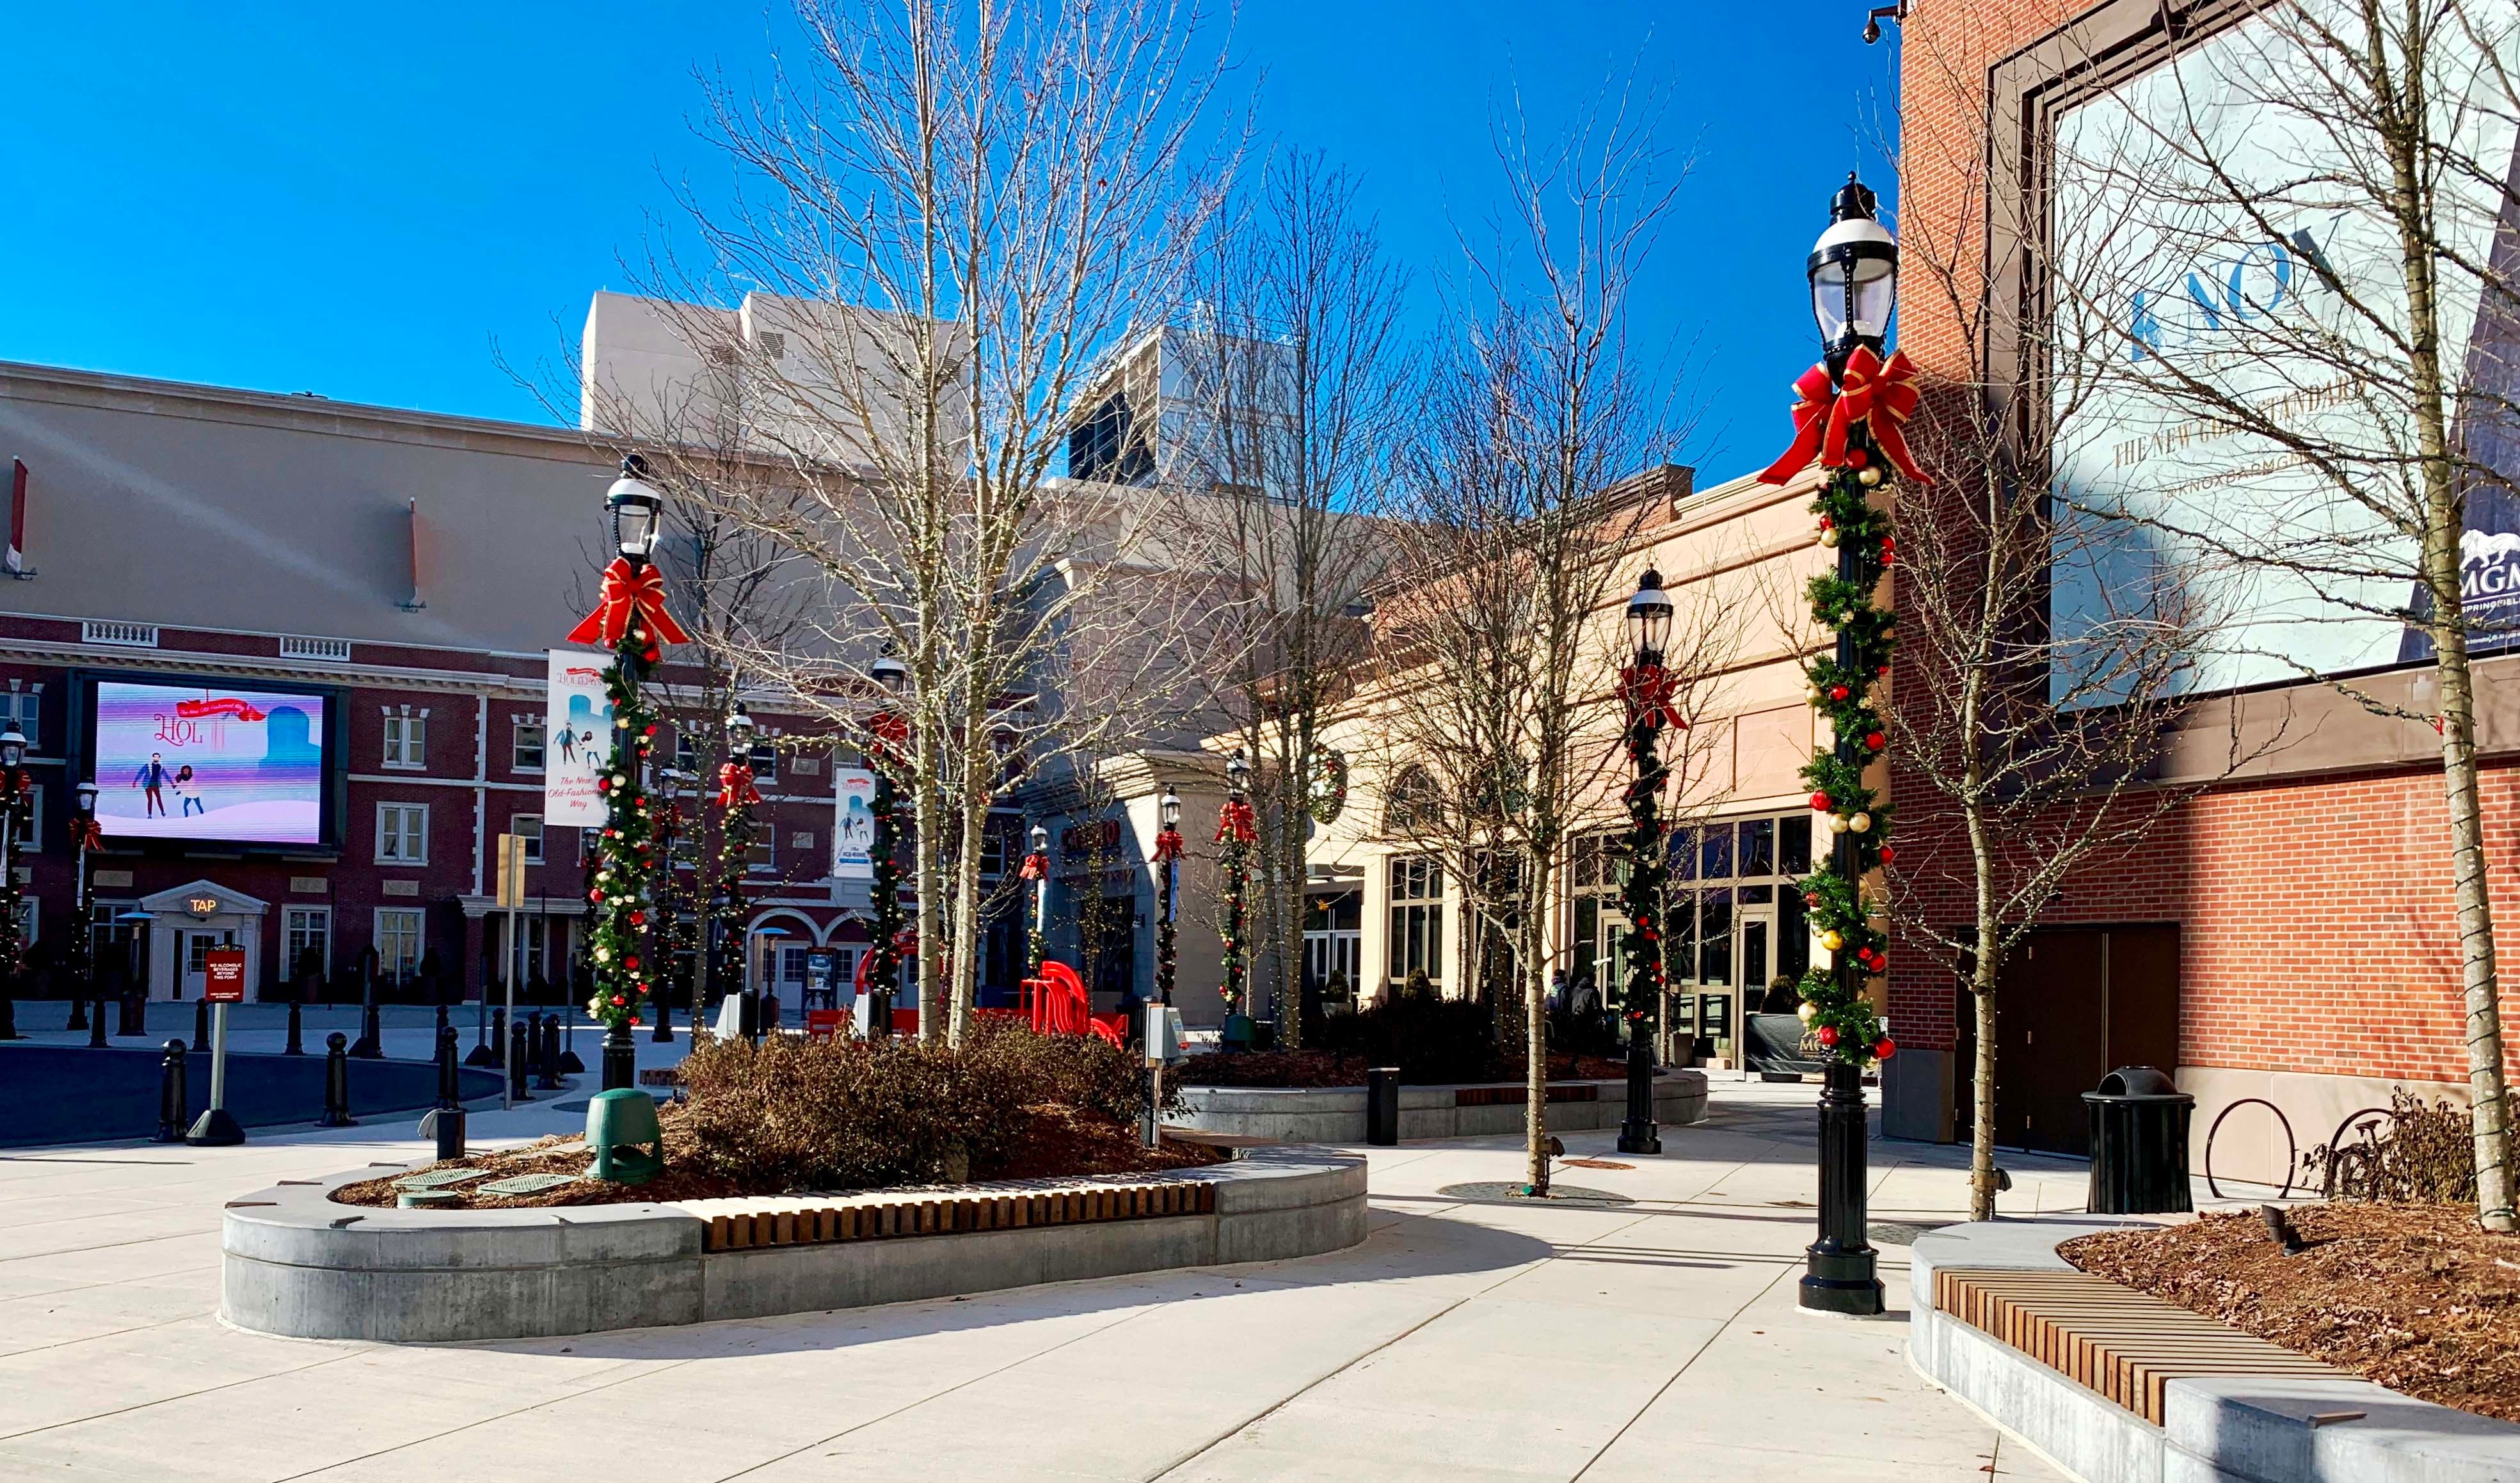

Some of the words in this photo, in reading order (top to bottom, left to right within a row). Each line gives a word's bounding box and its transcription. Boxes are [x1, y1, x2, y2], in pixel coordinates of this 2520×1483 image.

[2113, 436, 2147, 469] THE
[2152, 422, 2192, 457] NEW
[2199, 408, 2249, 443] GOL
[2256, 374, 2366, 424] TANDARD
[2462, 598, 2520, 614] SPRINGFIEL
[561, 776, 573, 785] The
[576, 776, 592, 784] New
[548, 788, 602, 798] Old-Fashione
[570, 798, 587, 811] Way
[1061, 818, 1120, 852] CASNO
[190, 899, 216, 912] TAP
